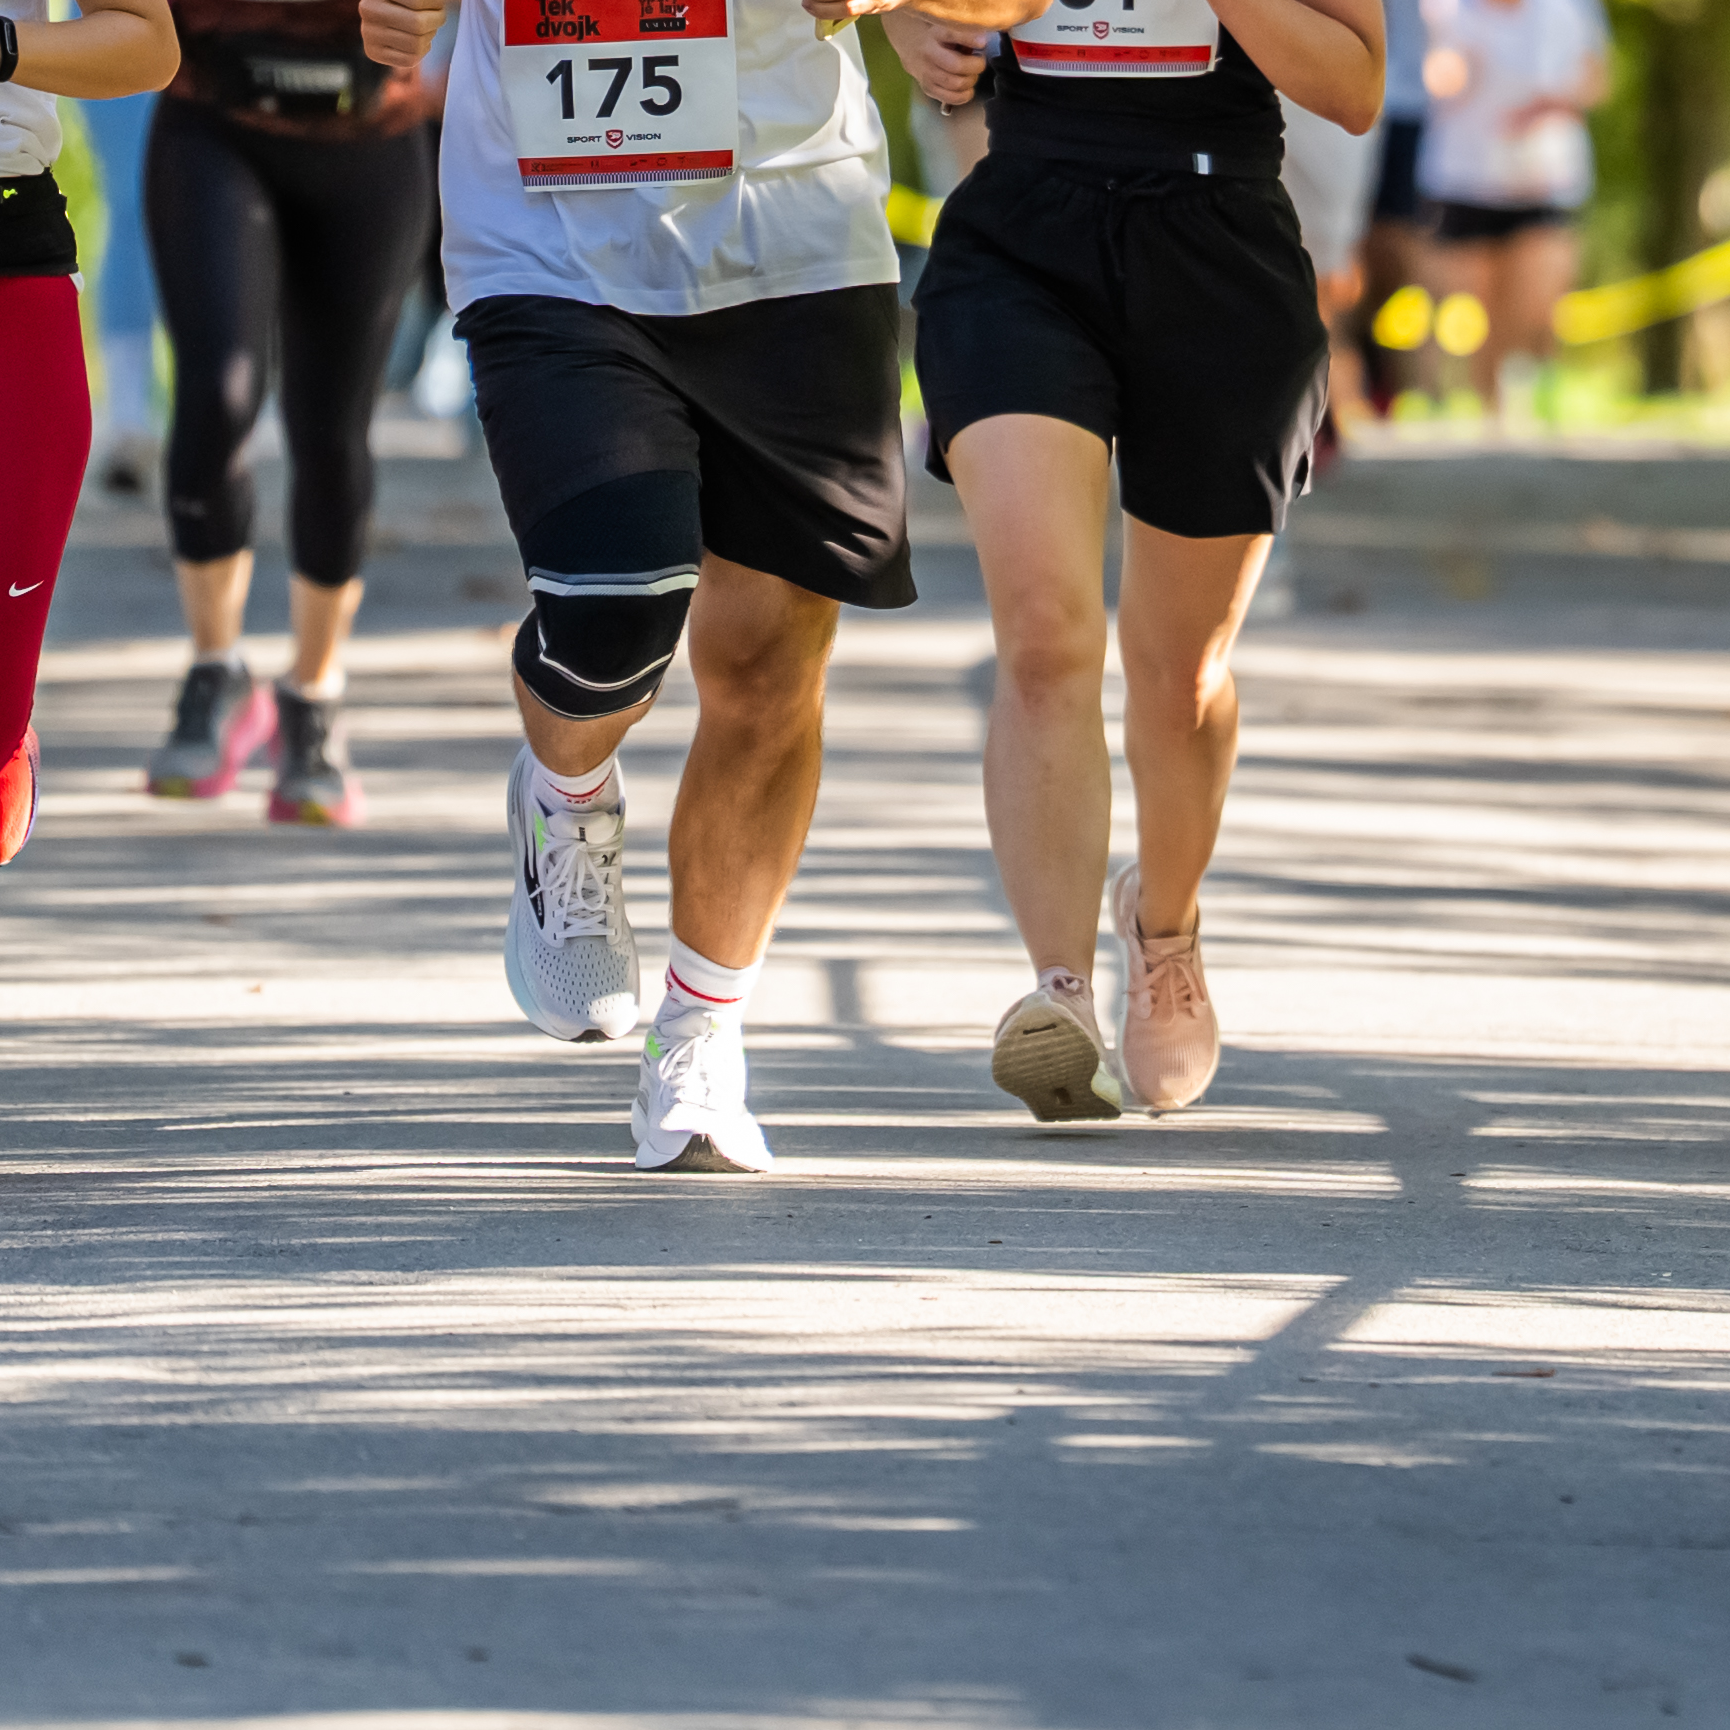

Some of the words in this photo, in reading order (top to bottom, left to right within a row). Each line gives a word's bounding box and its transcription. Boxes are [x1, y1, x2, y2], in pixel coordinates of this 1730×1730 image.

[535, 14, 601, 42] dvojk
[1056, 24, 1090, 32] SPORT
[1111, 26, 1145, 34] VISION
[545, 54, 683, 120] 175
[566, 135, 602, 144] SPORT
[625, 132, 662, 141] VISION
